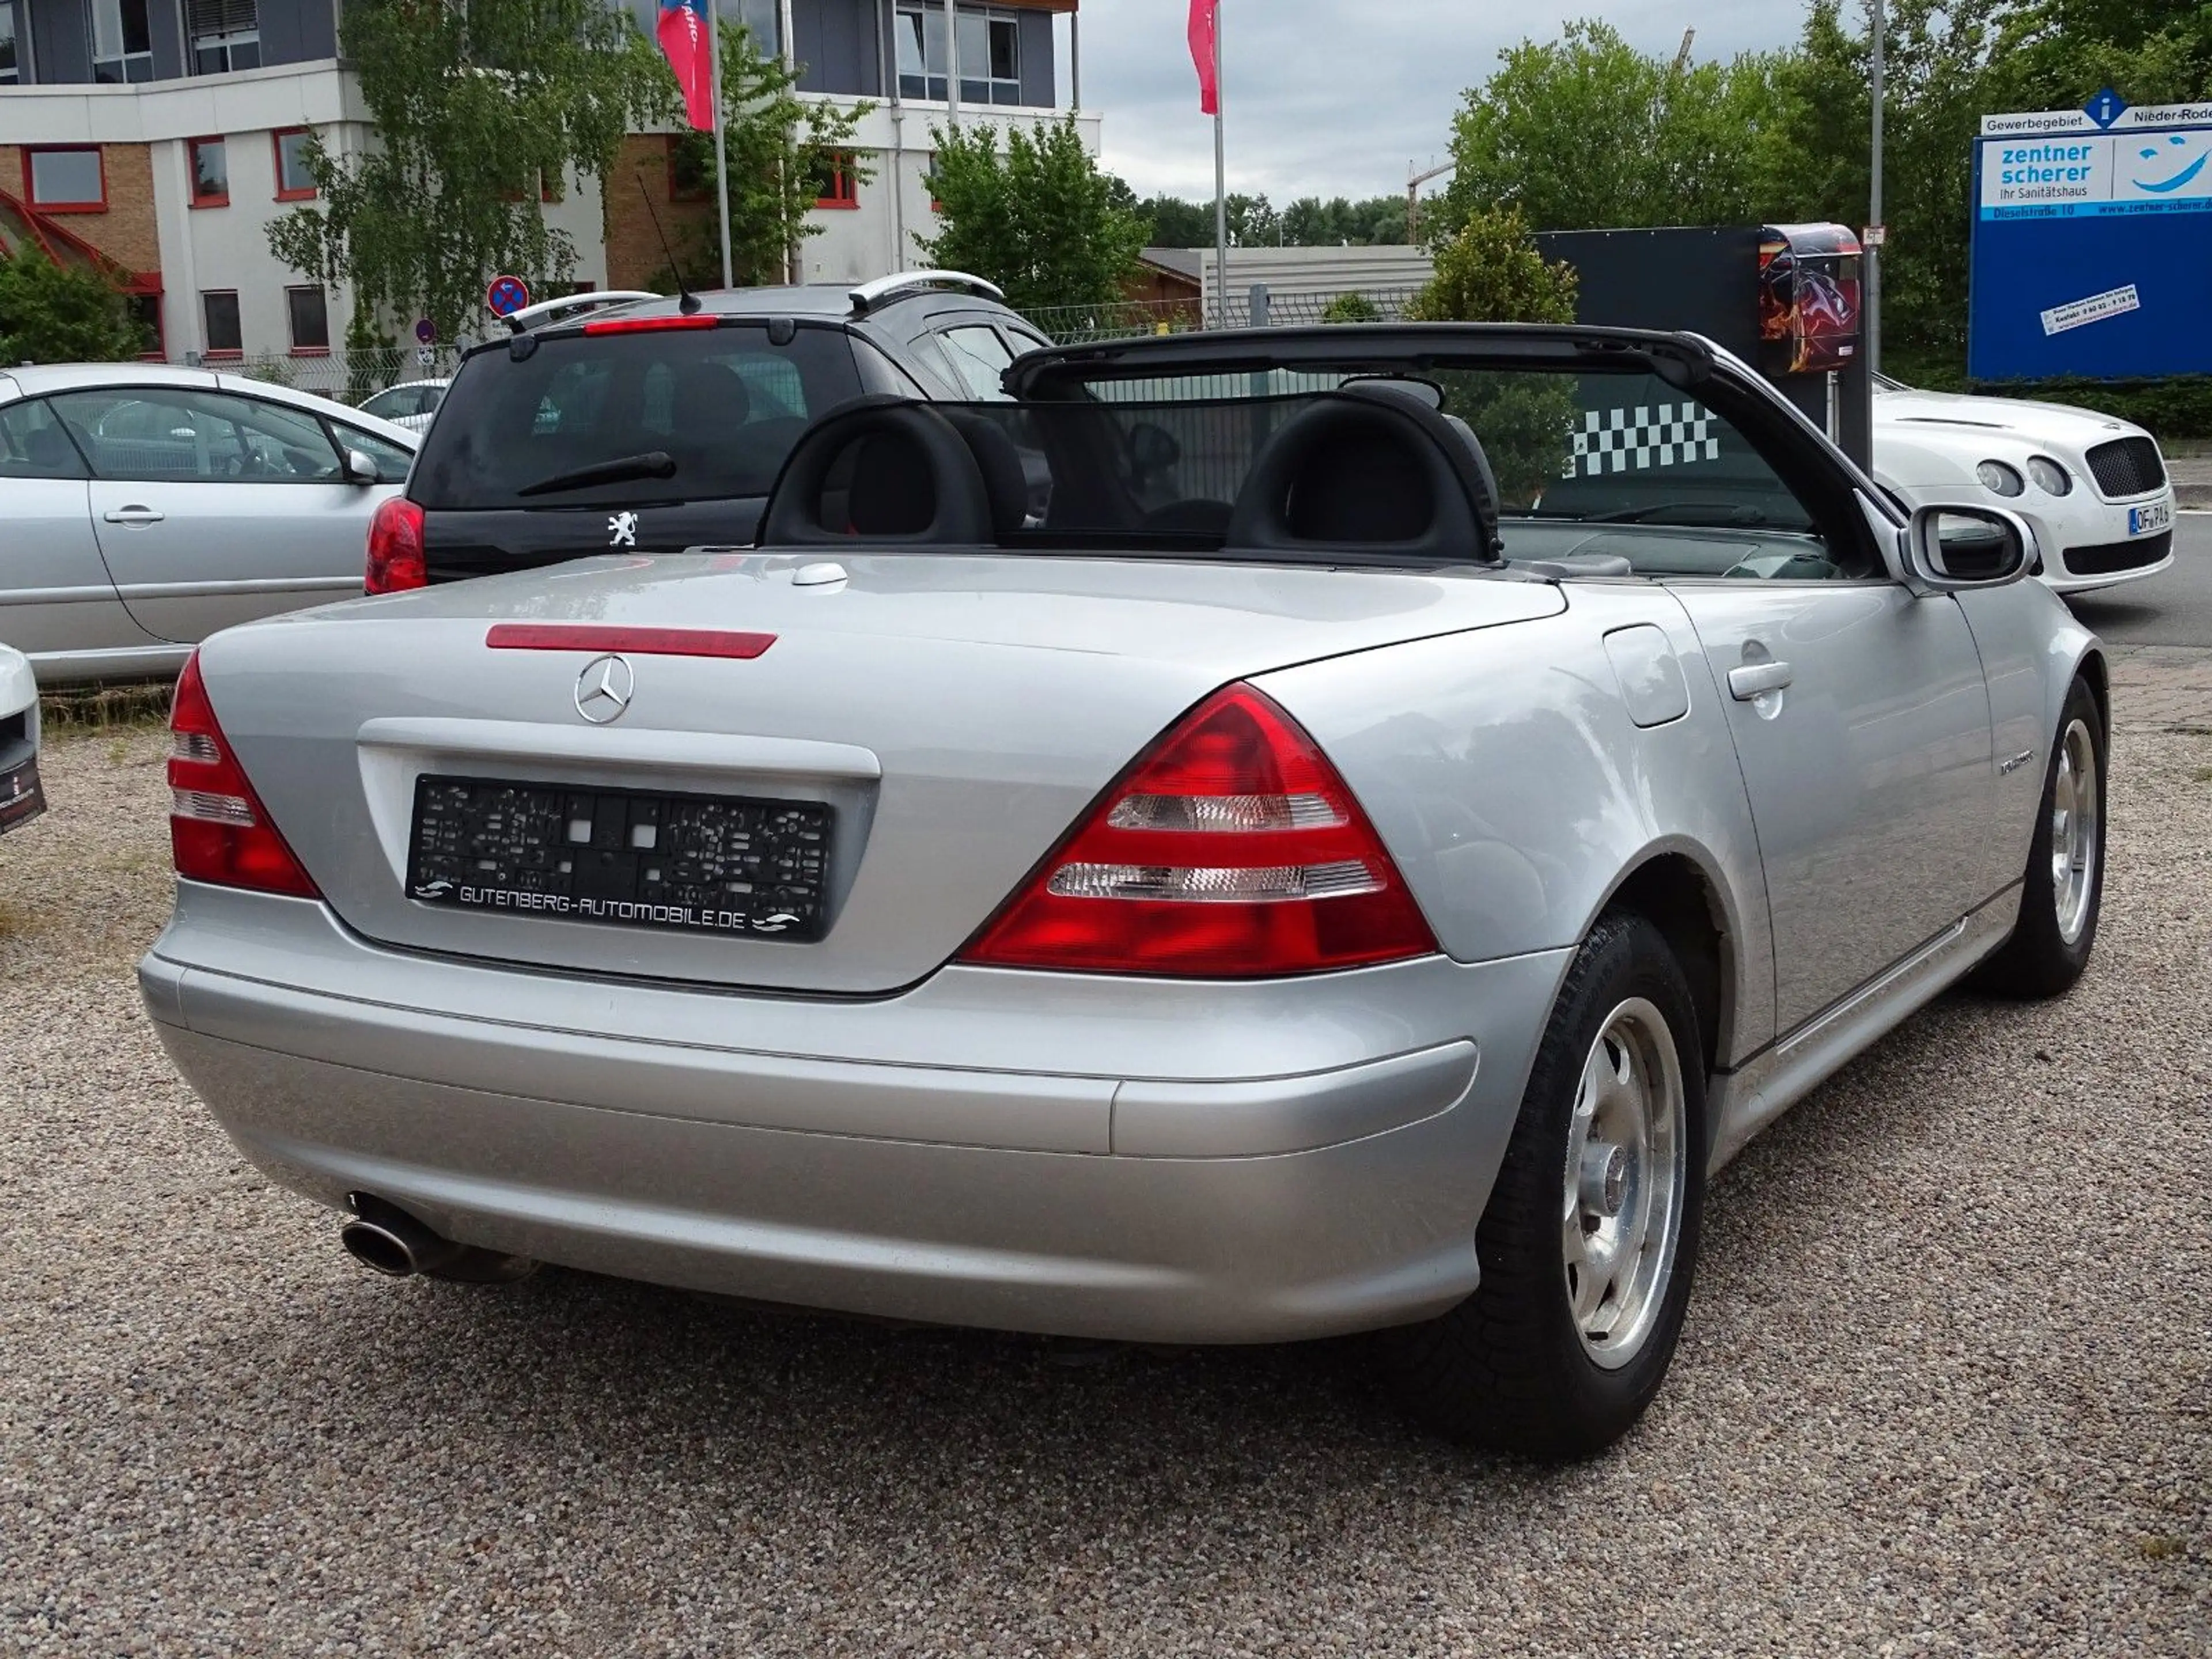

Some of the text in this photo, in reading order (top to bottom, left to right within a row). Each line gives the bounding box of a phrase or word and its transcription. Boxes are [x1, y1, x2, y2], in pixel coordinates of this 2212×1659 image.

[1987, 116, 2083, 131] Gewerbegebiet
[2002, 145, 2093, 164] zentner
[2001, 165, 2092, 184] scherer
[2000, 186, 2088, 199] Ihr Sanitätshaus
[1994, 204, 2074, 218] Dieselstraße 10
[460, 886, 746, 929] GUTENBERG-AUTOMOBILE.DE
